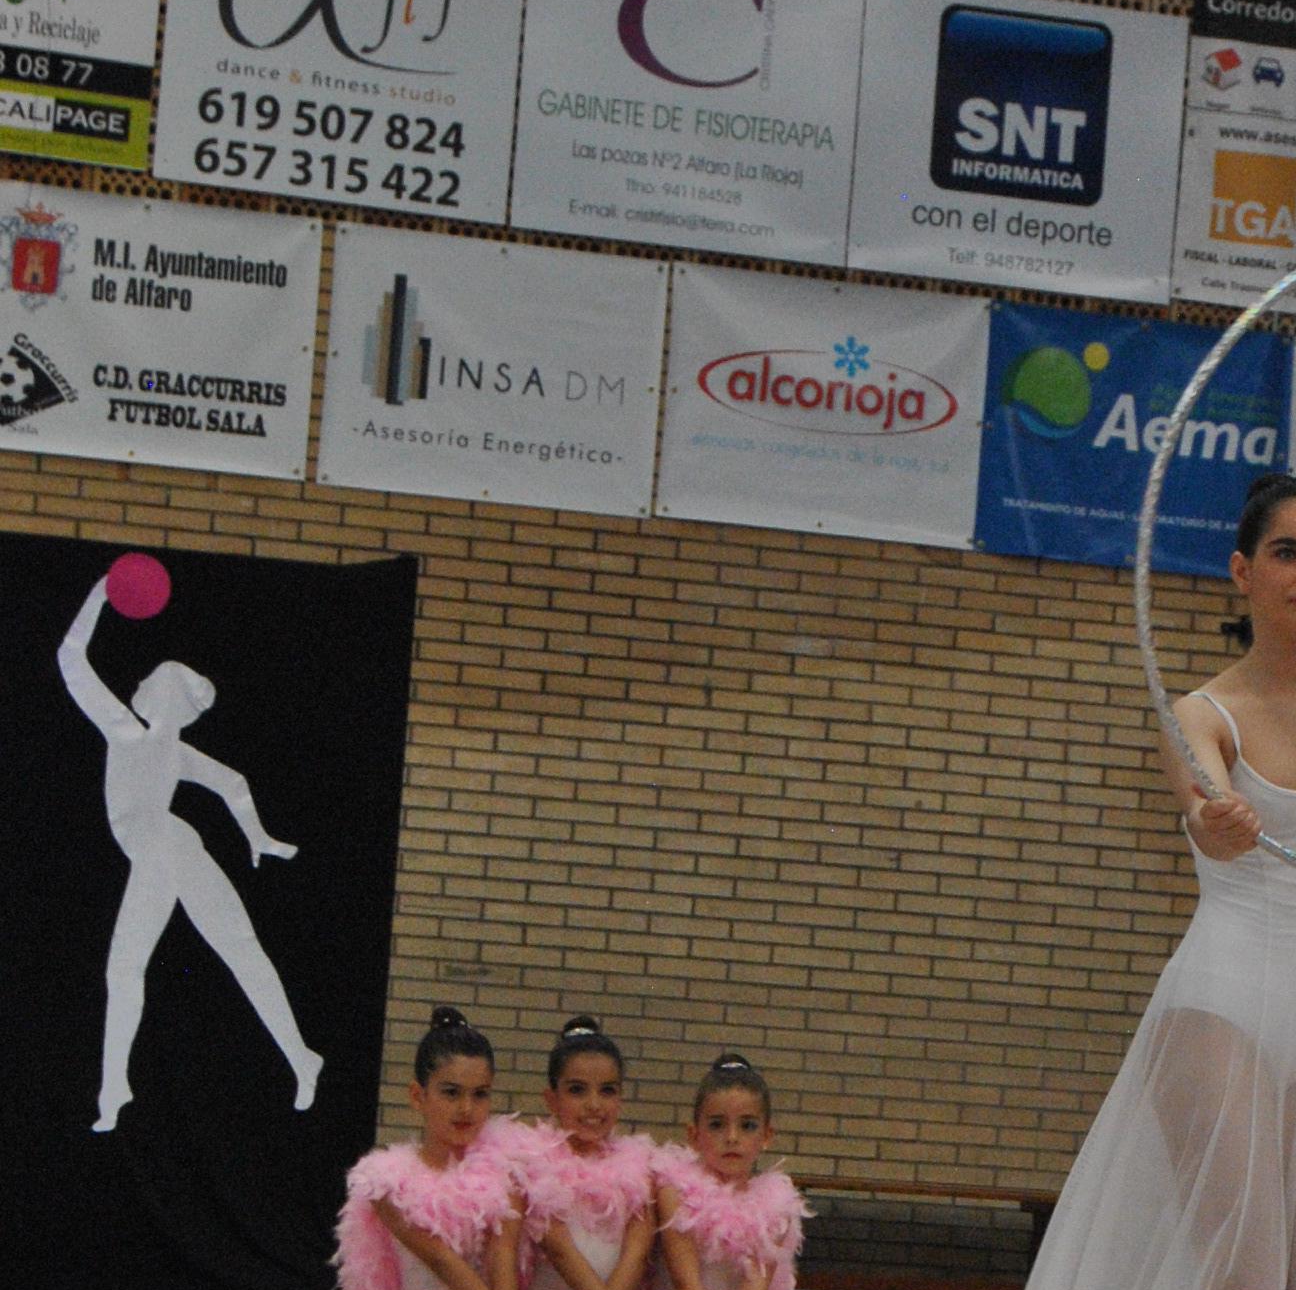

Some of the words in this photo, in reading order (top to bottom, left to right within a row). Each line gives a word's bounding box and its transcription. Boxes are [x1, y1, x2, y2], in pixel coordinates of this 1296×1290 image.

[11, 15, 23, 38] y
[28, 10, 101, 48] Reciclaje
[16, 53, 50, 80] 08
[60, 60, 94, 85] 77
[216, 58, 281, 81] dance
[311, 71, 381, 96] fitness
[388, 84, 457, 107] studio
[198, 86, 281, 131] 619
[292, 98, 374, 144] 507
[384, 112, 466, 158] 824
[536, 88, 645, 128] GABINETE
[652, 104, 684, 132] DE
[694, 108, 835, 152] FISIOTERAPIA
[955, 96, 1087, 164] SNT
[194, 137, 278, 180] 657
[288, 148, 370, 194] 315
[381, 162, 462, 207] 422
[571, 139, 597, 160] Las
[685, 155, 731, 175] Alfaro
[952, 158, 1084, 190] INFORMATICA
[911, 205, 962, 229] con
[972, 208, 997, 232] el
[1006, 210, 1113, 246] deporte
[1211, 197, 1296, 241] TGA
[94, 237, 137, 271] M.I.
[145, 243, 288, 289] Ayuntamiento
[91, 274, 117, 302] de
[124, 277, 192, 312] Alfaro
[92, 363, 133, 391] C.D.
[138, 368, 287, 407] GRACCURRIS
[438, 355, 546, 398] INSA
[564, 369, 626, 407] DM
[726, 355, 927, 432] alcorioja
[107, 397, 201, 431] FUTBOL
[206, 409, 267, 437] SALA
[1092, 392, 1279, 467] Aema
